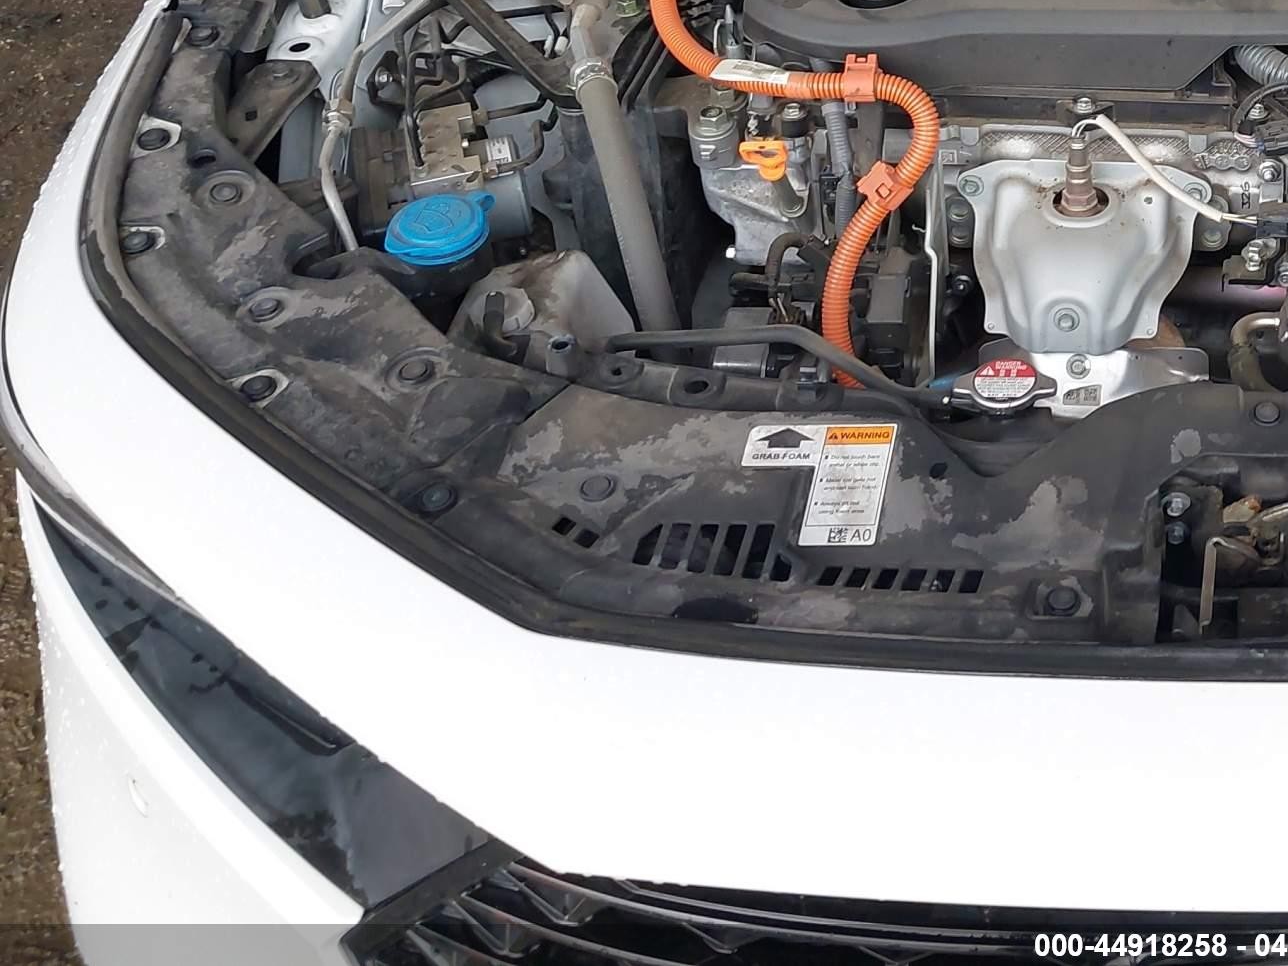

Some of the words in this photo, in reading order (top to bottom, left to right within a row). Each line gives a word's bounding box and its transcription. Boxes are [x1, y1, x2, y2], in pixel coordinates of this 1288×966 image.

[840, 430, 891, 441] WARNING
[751, 452, 780, 461] GRAB
[781, 452, 811, 461] FOAM
